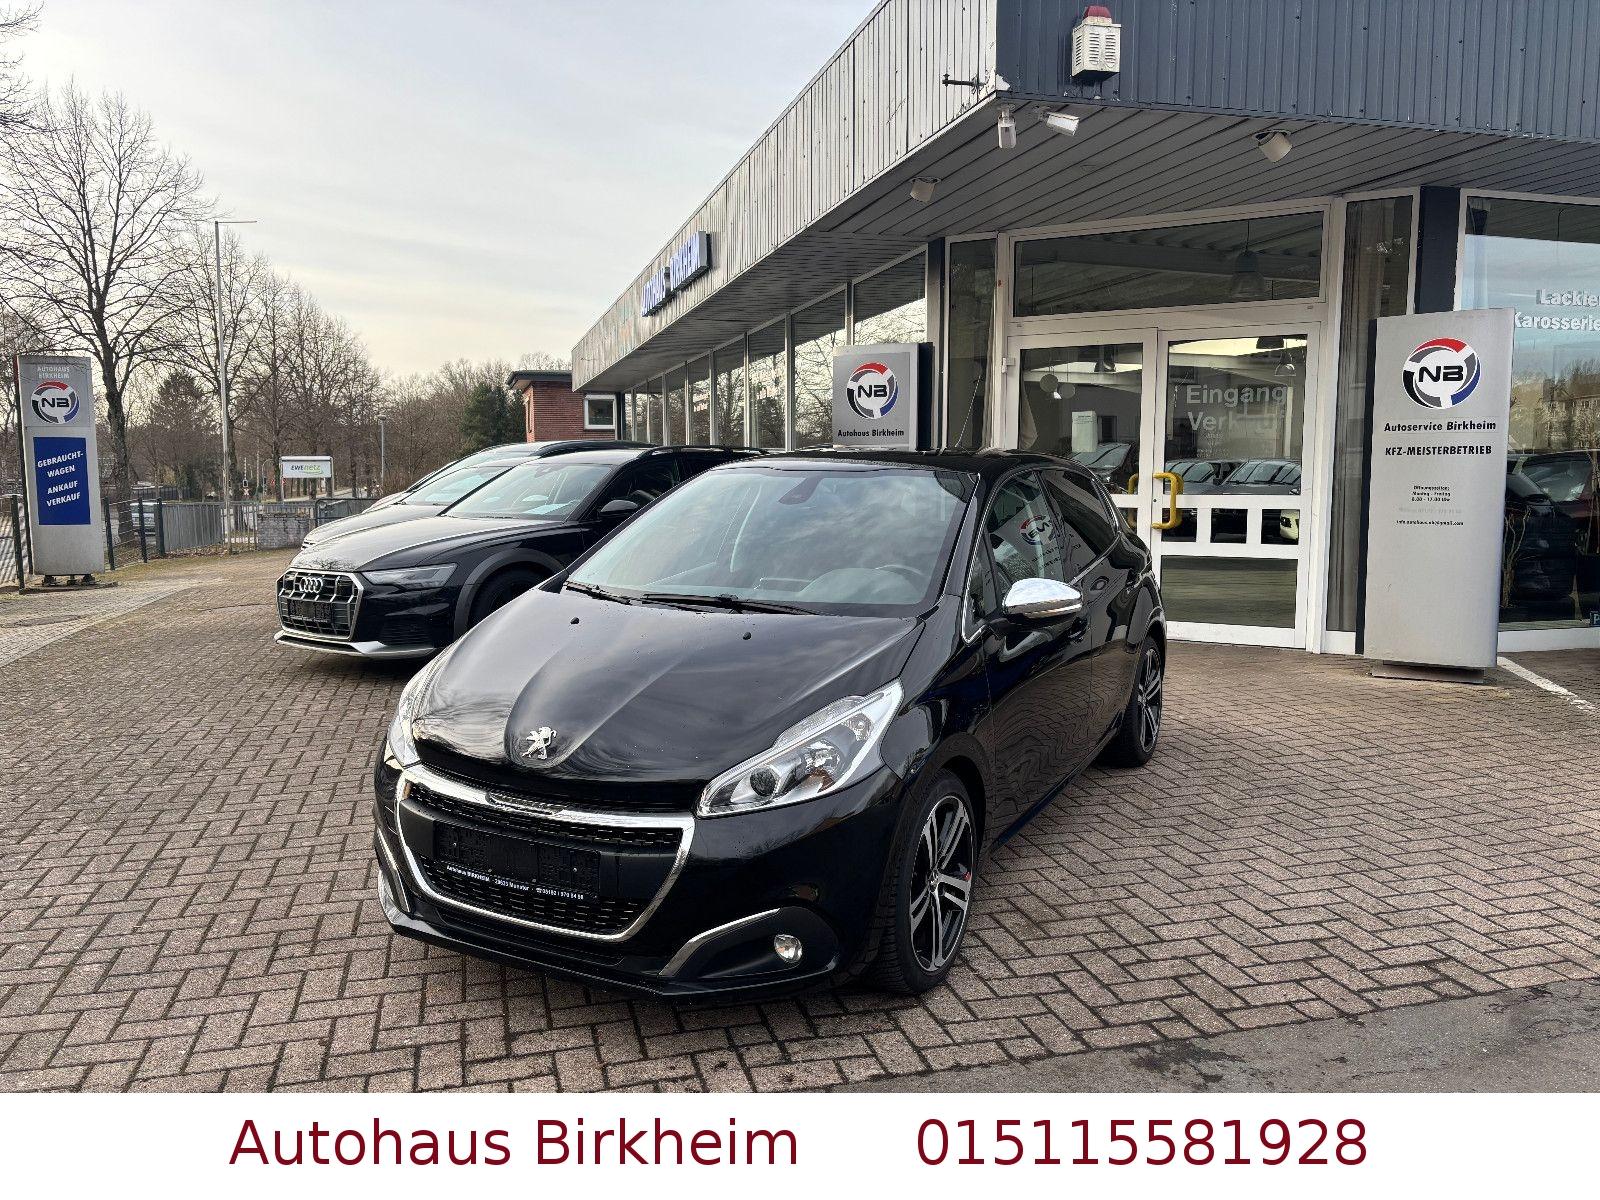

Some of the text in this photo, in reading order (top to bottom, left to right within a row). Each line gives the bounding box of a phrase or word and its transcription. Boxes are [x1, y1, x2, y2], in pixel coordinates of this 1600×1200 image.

[1540, 288, 1600, 308] Lackie
[1418, 365, 1464, 383] NB
[858, 384, 888, 398] NB
[1186, 384, 1287, 408] Eingang
[41, 397, 70, 409] NB
[837, 428, 905, 437] Autohaus Birkheim
[1384, 420, 1497, 432] Autoservice Birkheim
[1385, 445, 1492, 456] KFZ-MEISTERBETRIEB
[37, 450, 84, 468] GEBRAUCHT-
[47, 464, 76, 478] WAGEN
[47, 480, 78, 495] ANKAUF
[46, 492, 81, 507] VERKAUF
